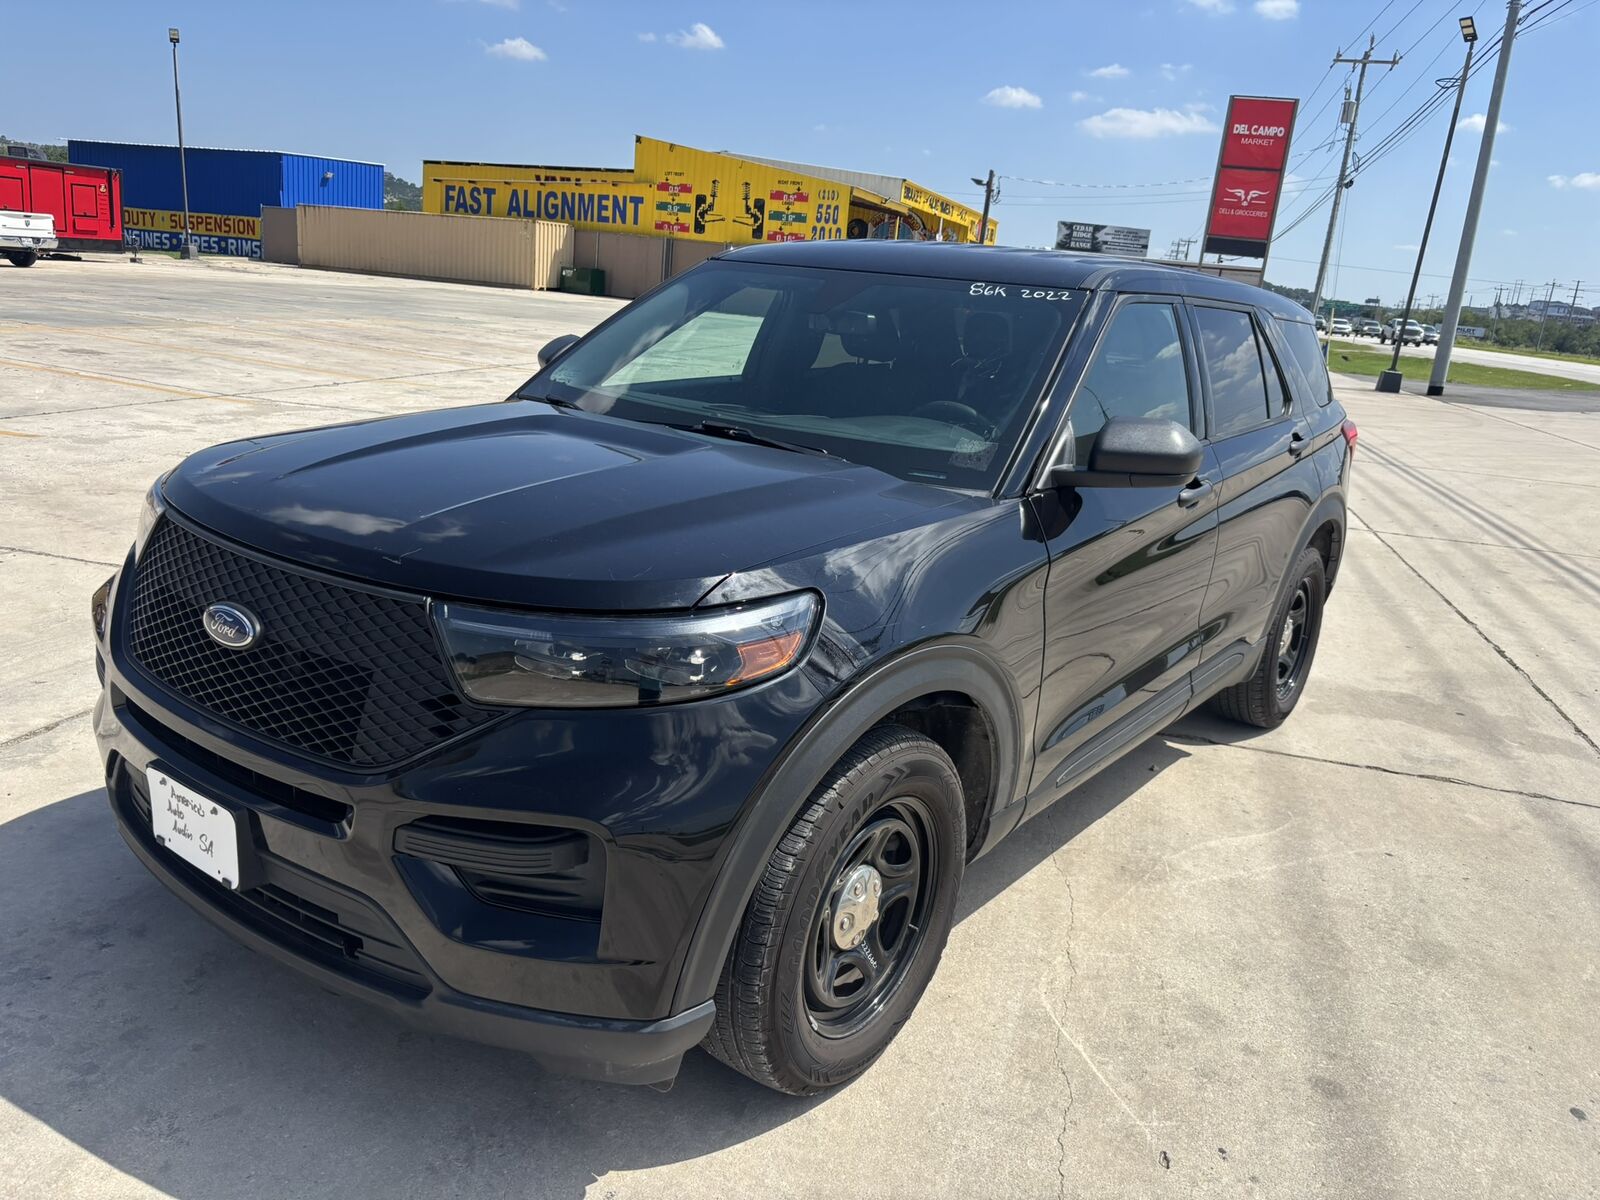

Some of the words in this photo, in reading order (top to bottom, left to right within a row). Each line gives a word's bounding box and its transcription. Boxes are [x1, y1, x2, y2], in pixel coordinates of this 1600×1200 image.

[1233, 124, 1250, 135] DEL
[1251, 125, 1285, 137] CAMPO
[1241, 138, 1274, 146] MARKET
[818, 189, 839, 201] (210)
[445, 185, 496, 215] FAST
[507, 188, 644, 226] ALIGNMENT
[816, 203, 839, 225] 550
[1219, 207, 1231, 215] DELI
[124, 209, 156, 227] DUTY
[170, 213, 256, 236] SUSPENSION
[811, 225, 842, 240] 2010
[124, 229, 170, 249] NGINES
[179, 230, 219, 253] TRES
[227, 238, 261, 257] RIMS
[1070, 241, 1092, 249] RANGE
[969, 283, 1006, 297] 86K
[1020, 289, 1072, 300] 2022
[211, 612, 240, 638] Ford
[199, 833, 214, 858] SA
